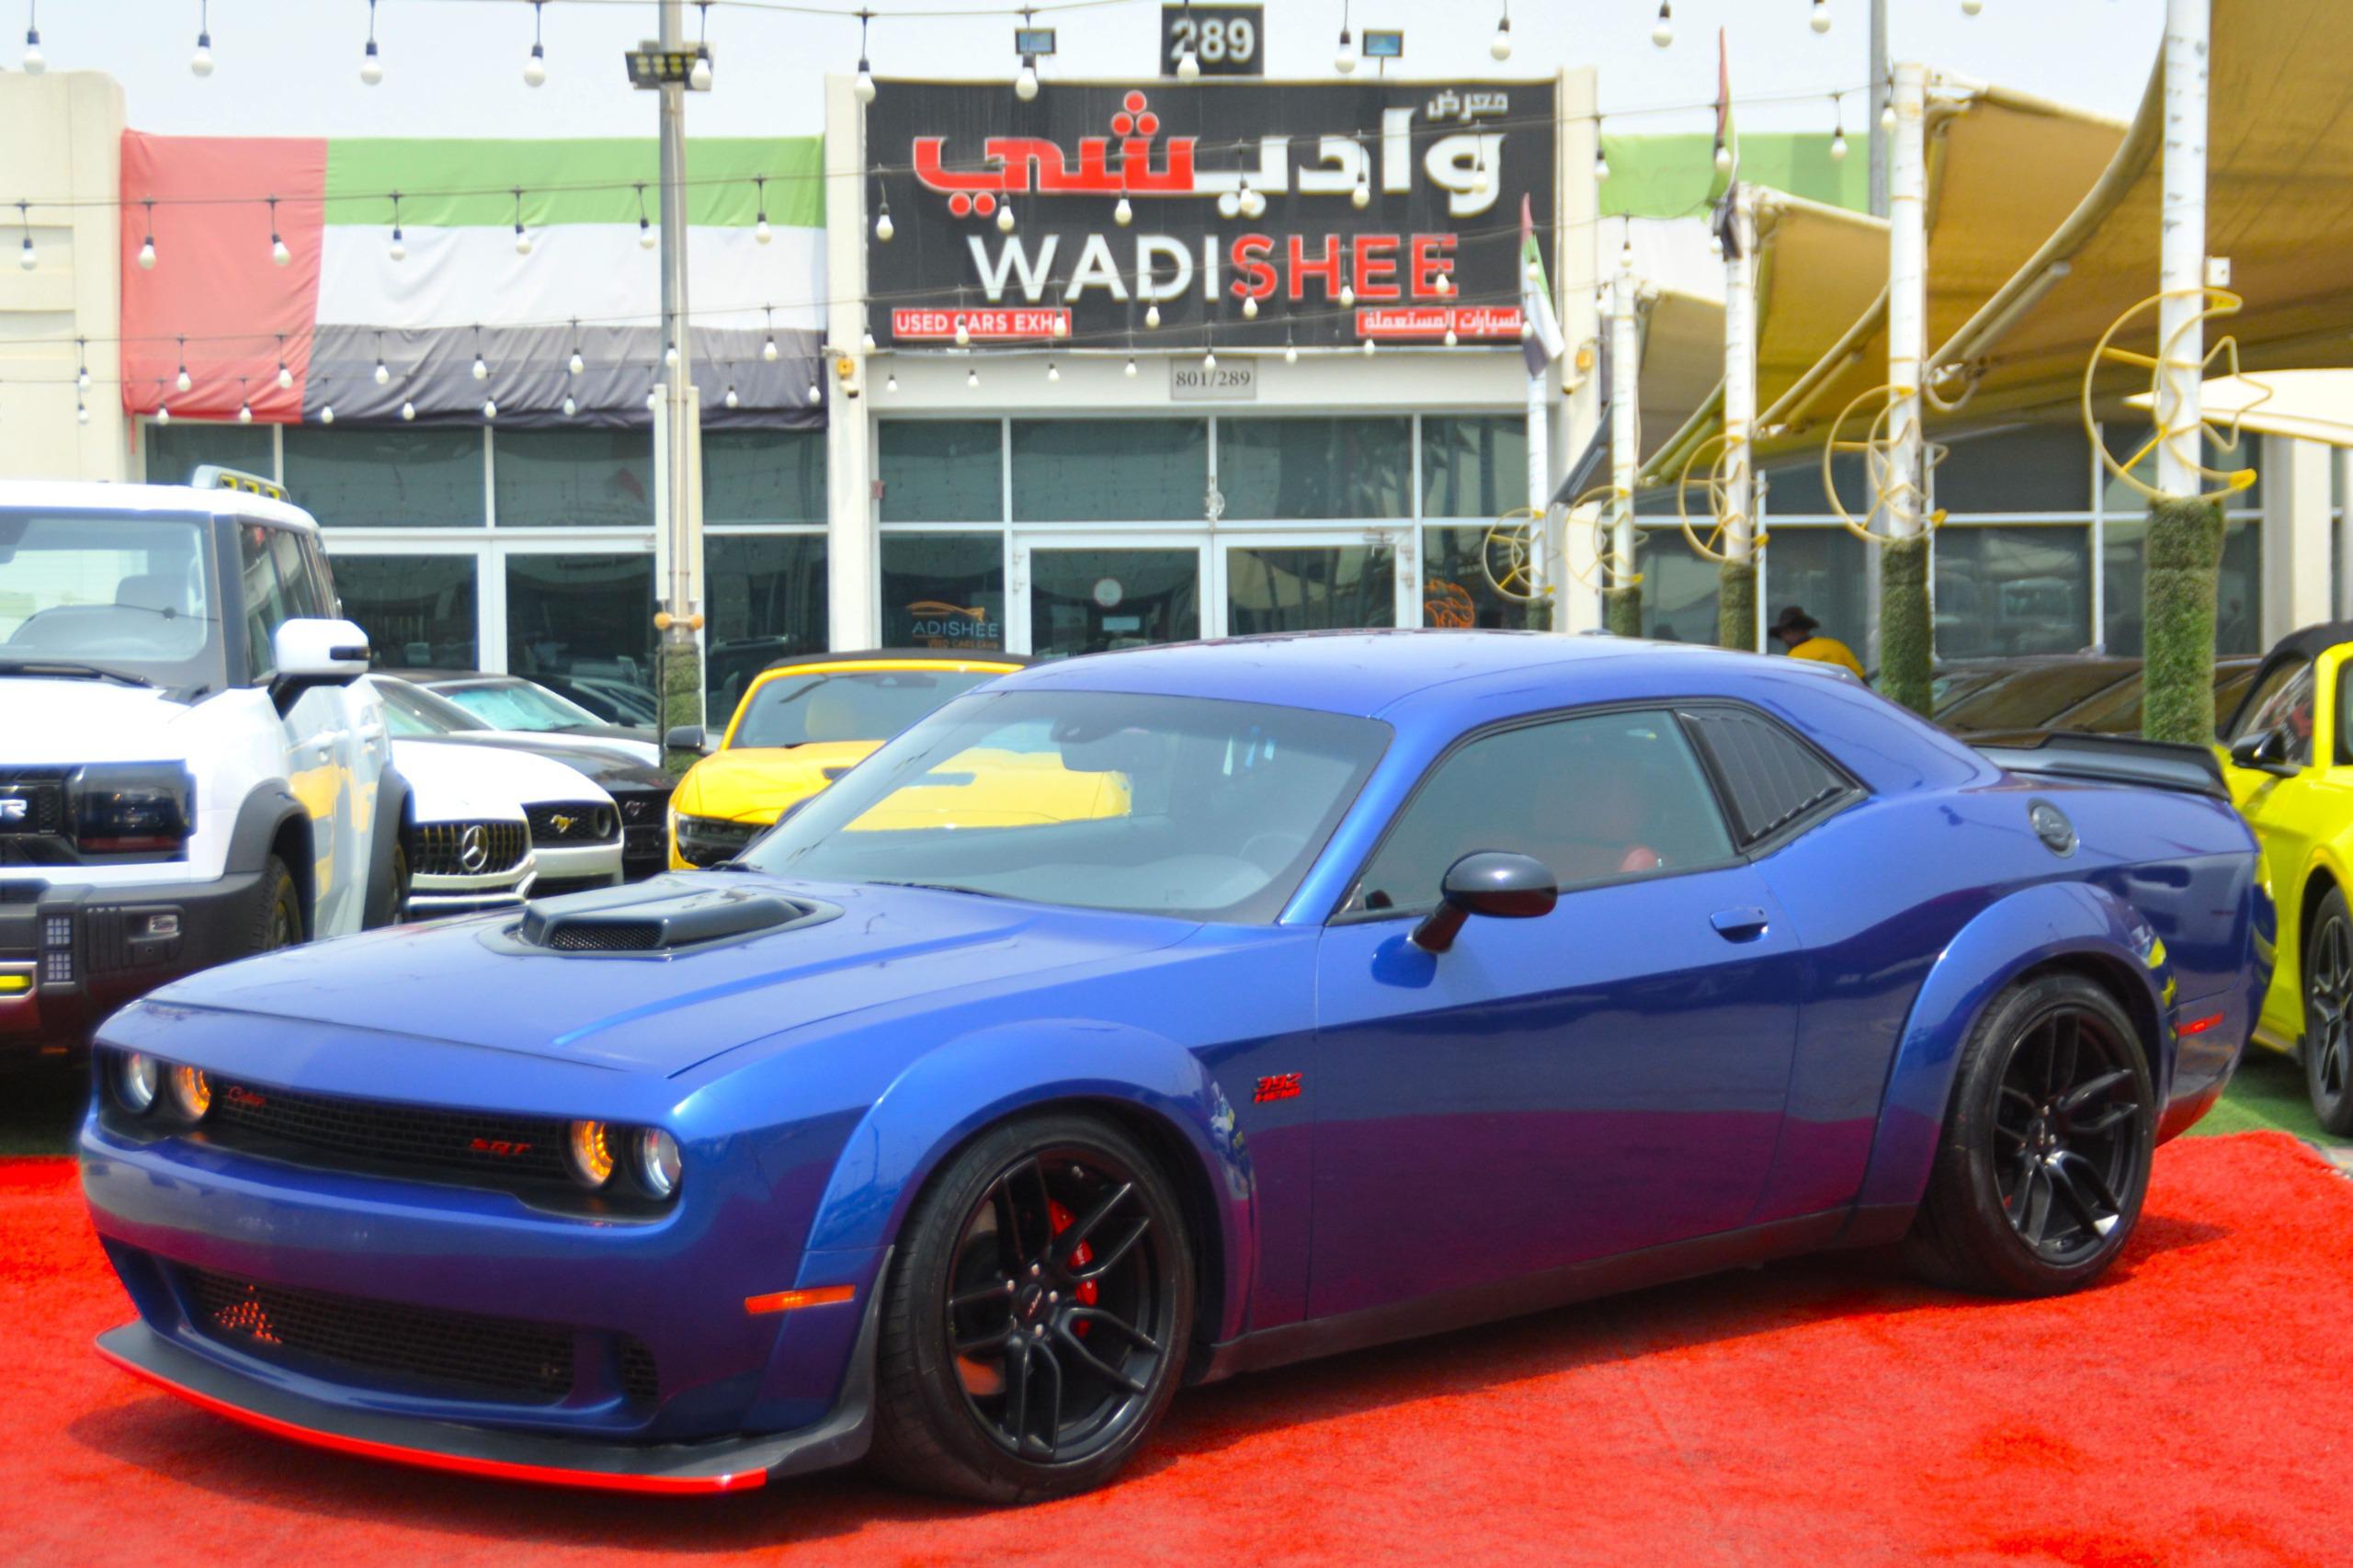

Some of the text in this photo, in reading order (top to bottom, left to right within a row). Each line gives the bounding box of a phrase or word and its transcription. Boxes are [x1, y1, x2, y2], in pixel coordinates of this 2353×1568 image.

[1171, 17, 1255, 60] 289
[1427, 89, 1508, 120] معرض
[968, 234, 1459, 301] WADISHEE
[897, 313, 1067, 332] USED CARS EXH
[1460, 309, 1522, 335] لسيارات
[1176, 369, 1251, 387] 801/289
[1256, 1072, 1303, 1092] 392
